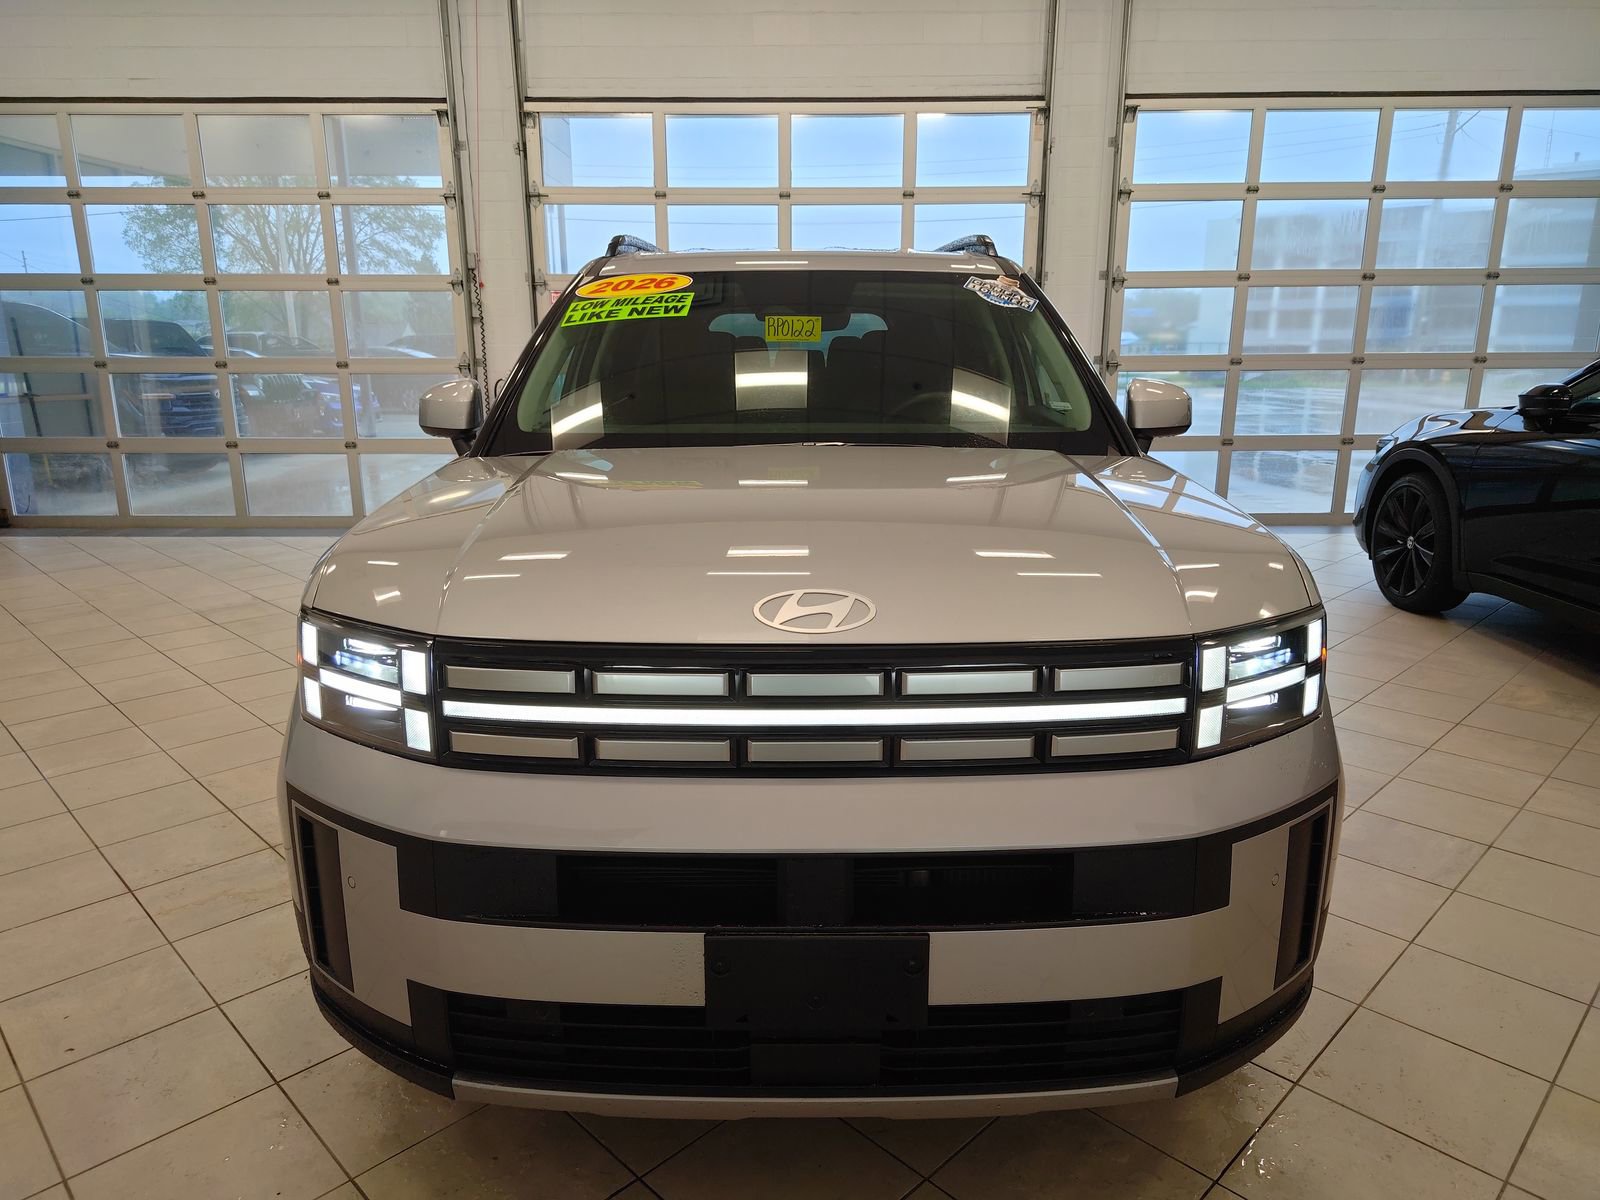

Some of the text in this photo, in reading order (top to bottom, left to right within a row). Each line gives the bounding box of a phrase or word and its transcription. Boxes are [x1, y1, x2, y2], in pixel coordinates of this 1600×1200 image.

[586, 276, 679, 295] 2026
[570, 295, 691, 312] LOW MILEAGE
[564, 305, 687, 324] LIKE NEW
